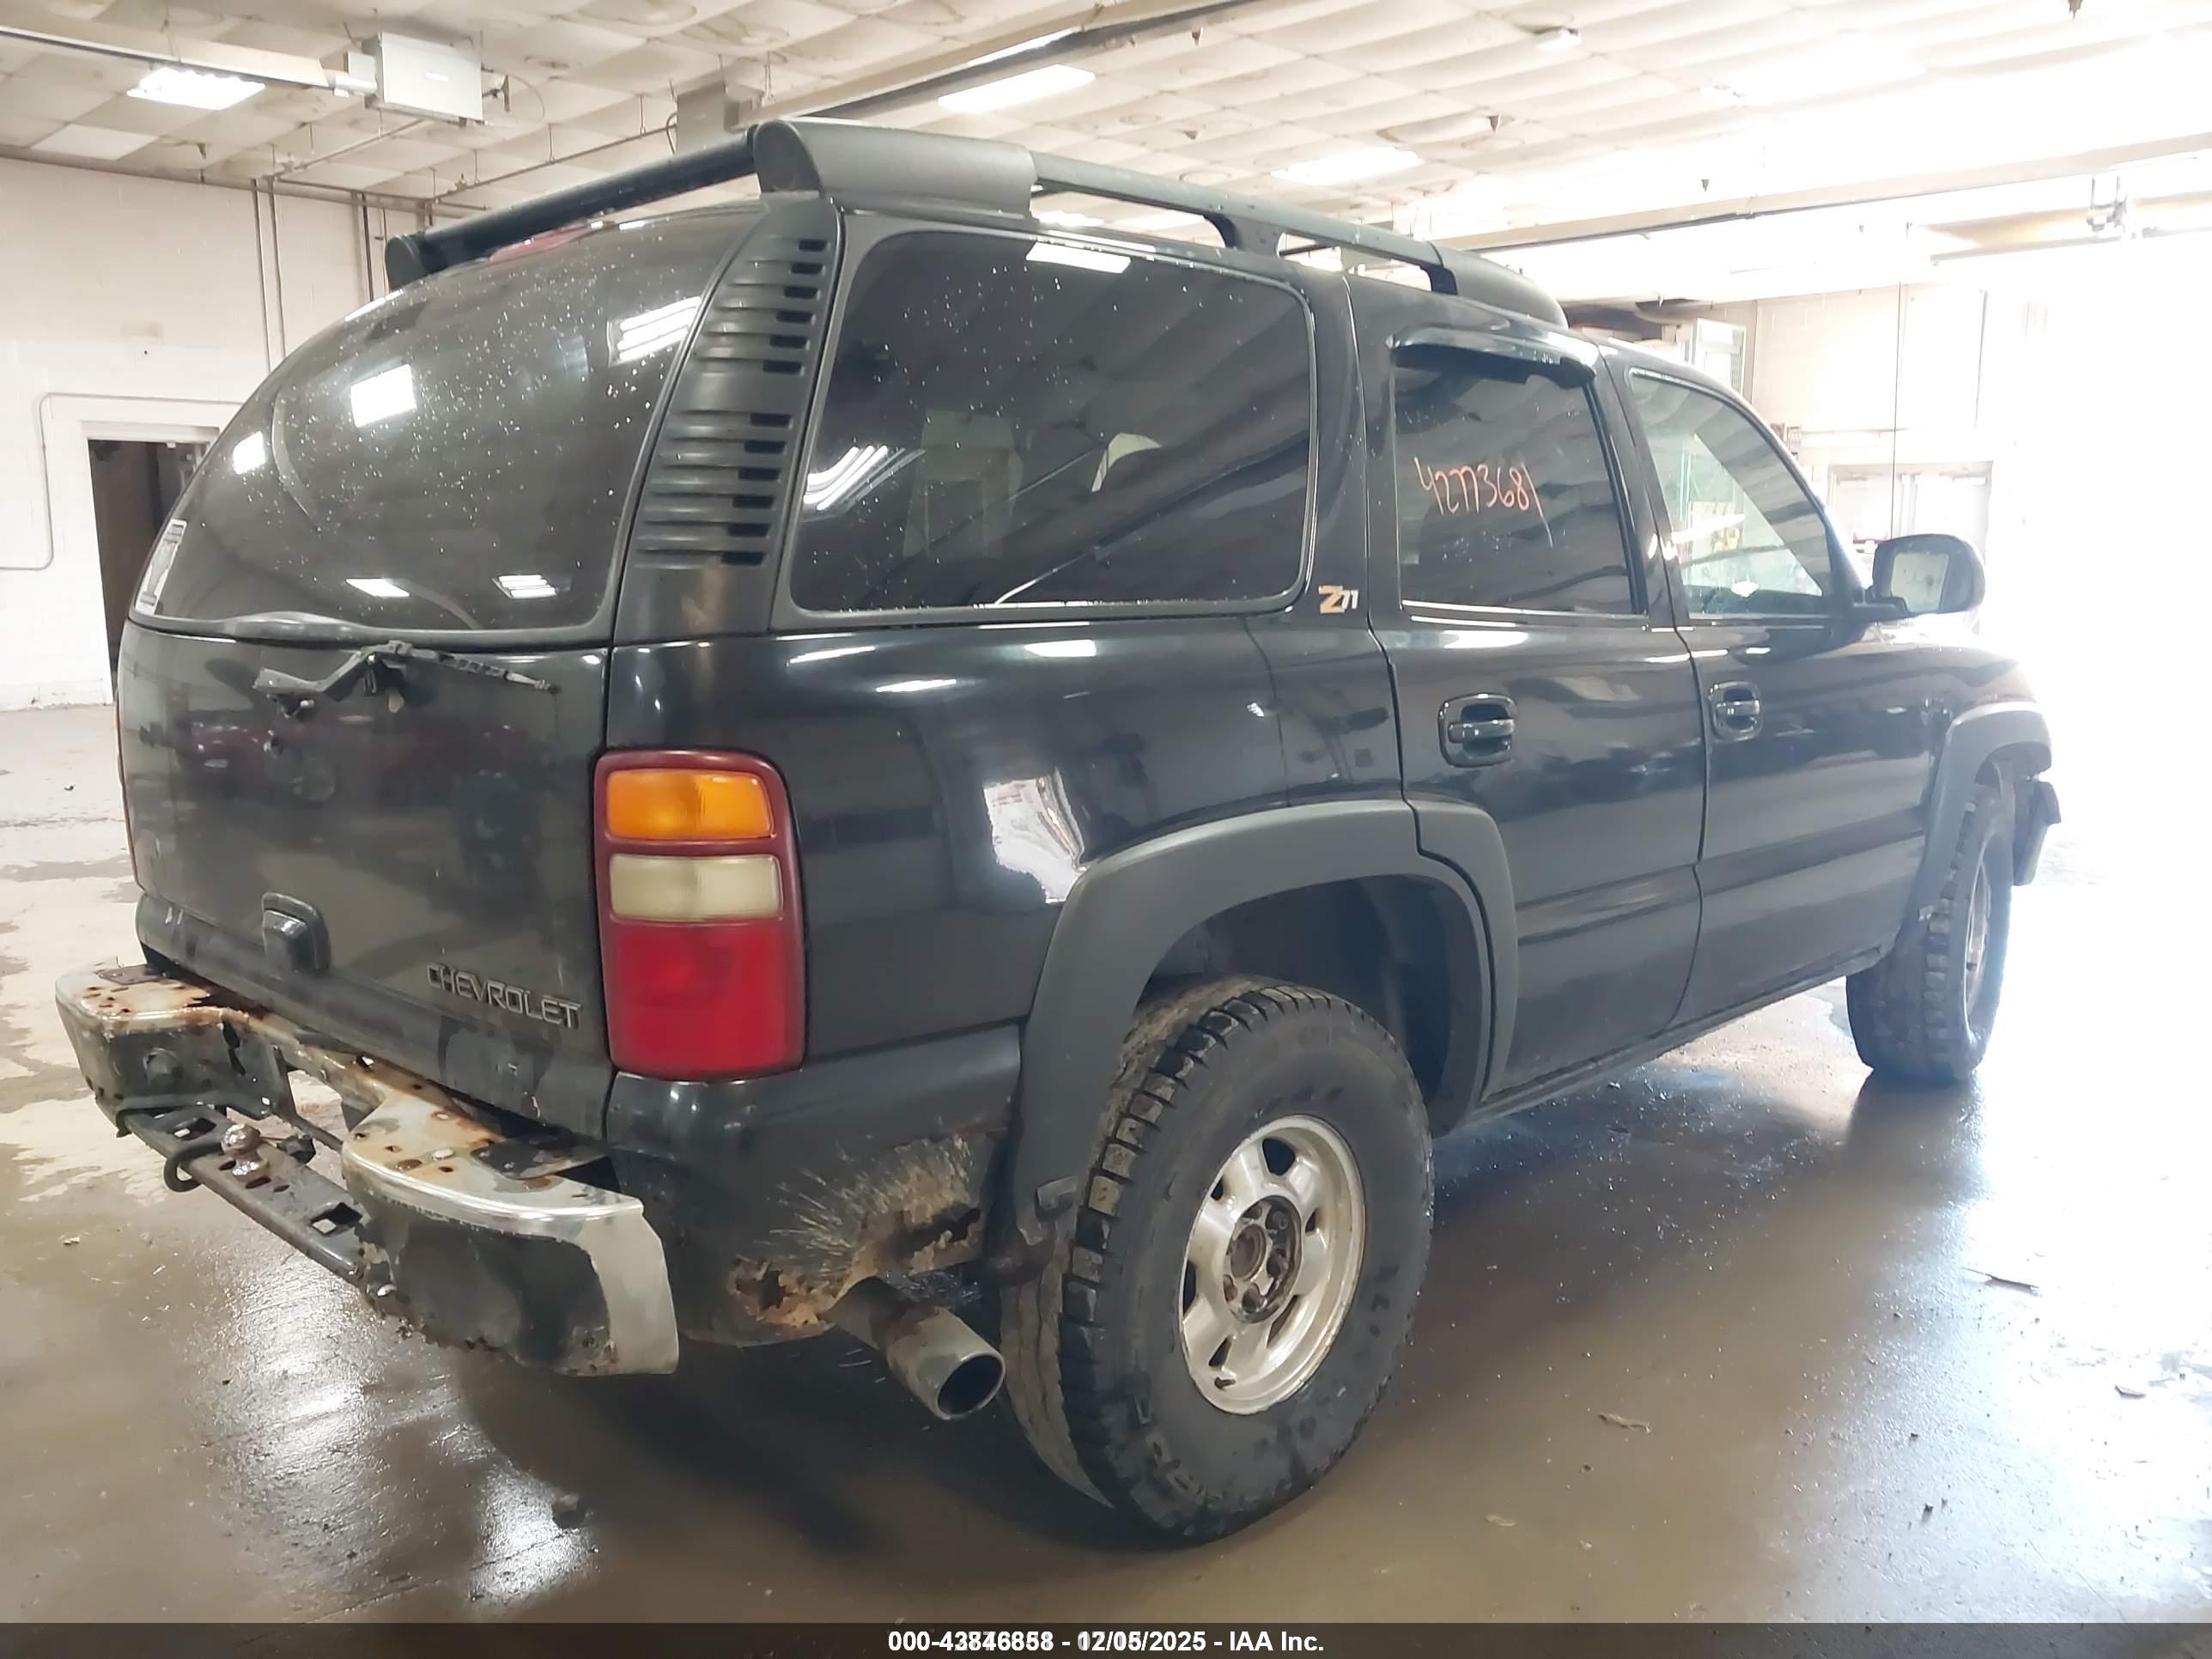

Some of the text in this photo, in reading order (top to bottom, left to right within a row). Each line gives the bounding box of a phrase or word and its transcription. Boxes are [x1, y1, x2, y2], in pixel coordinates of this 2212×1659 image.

[1413, 456, 1553, 548] 42773681
[1318, 585, 1359, 614] Z71
[426, 962, 581, 1029] CHEVROLET
